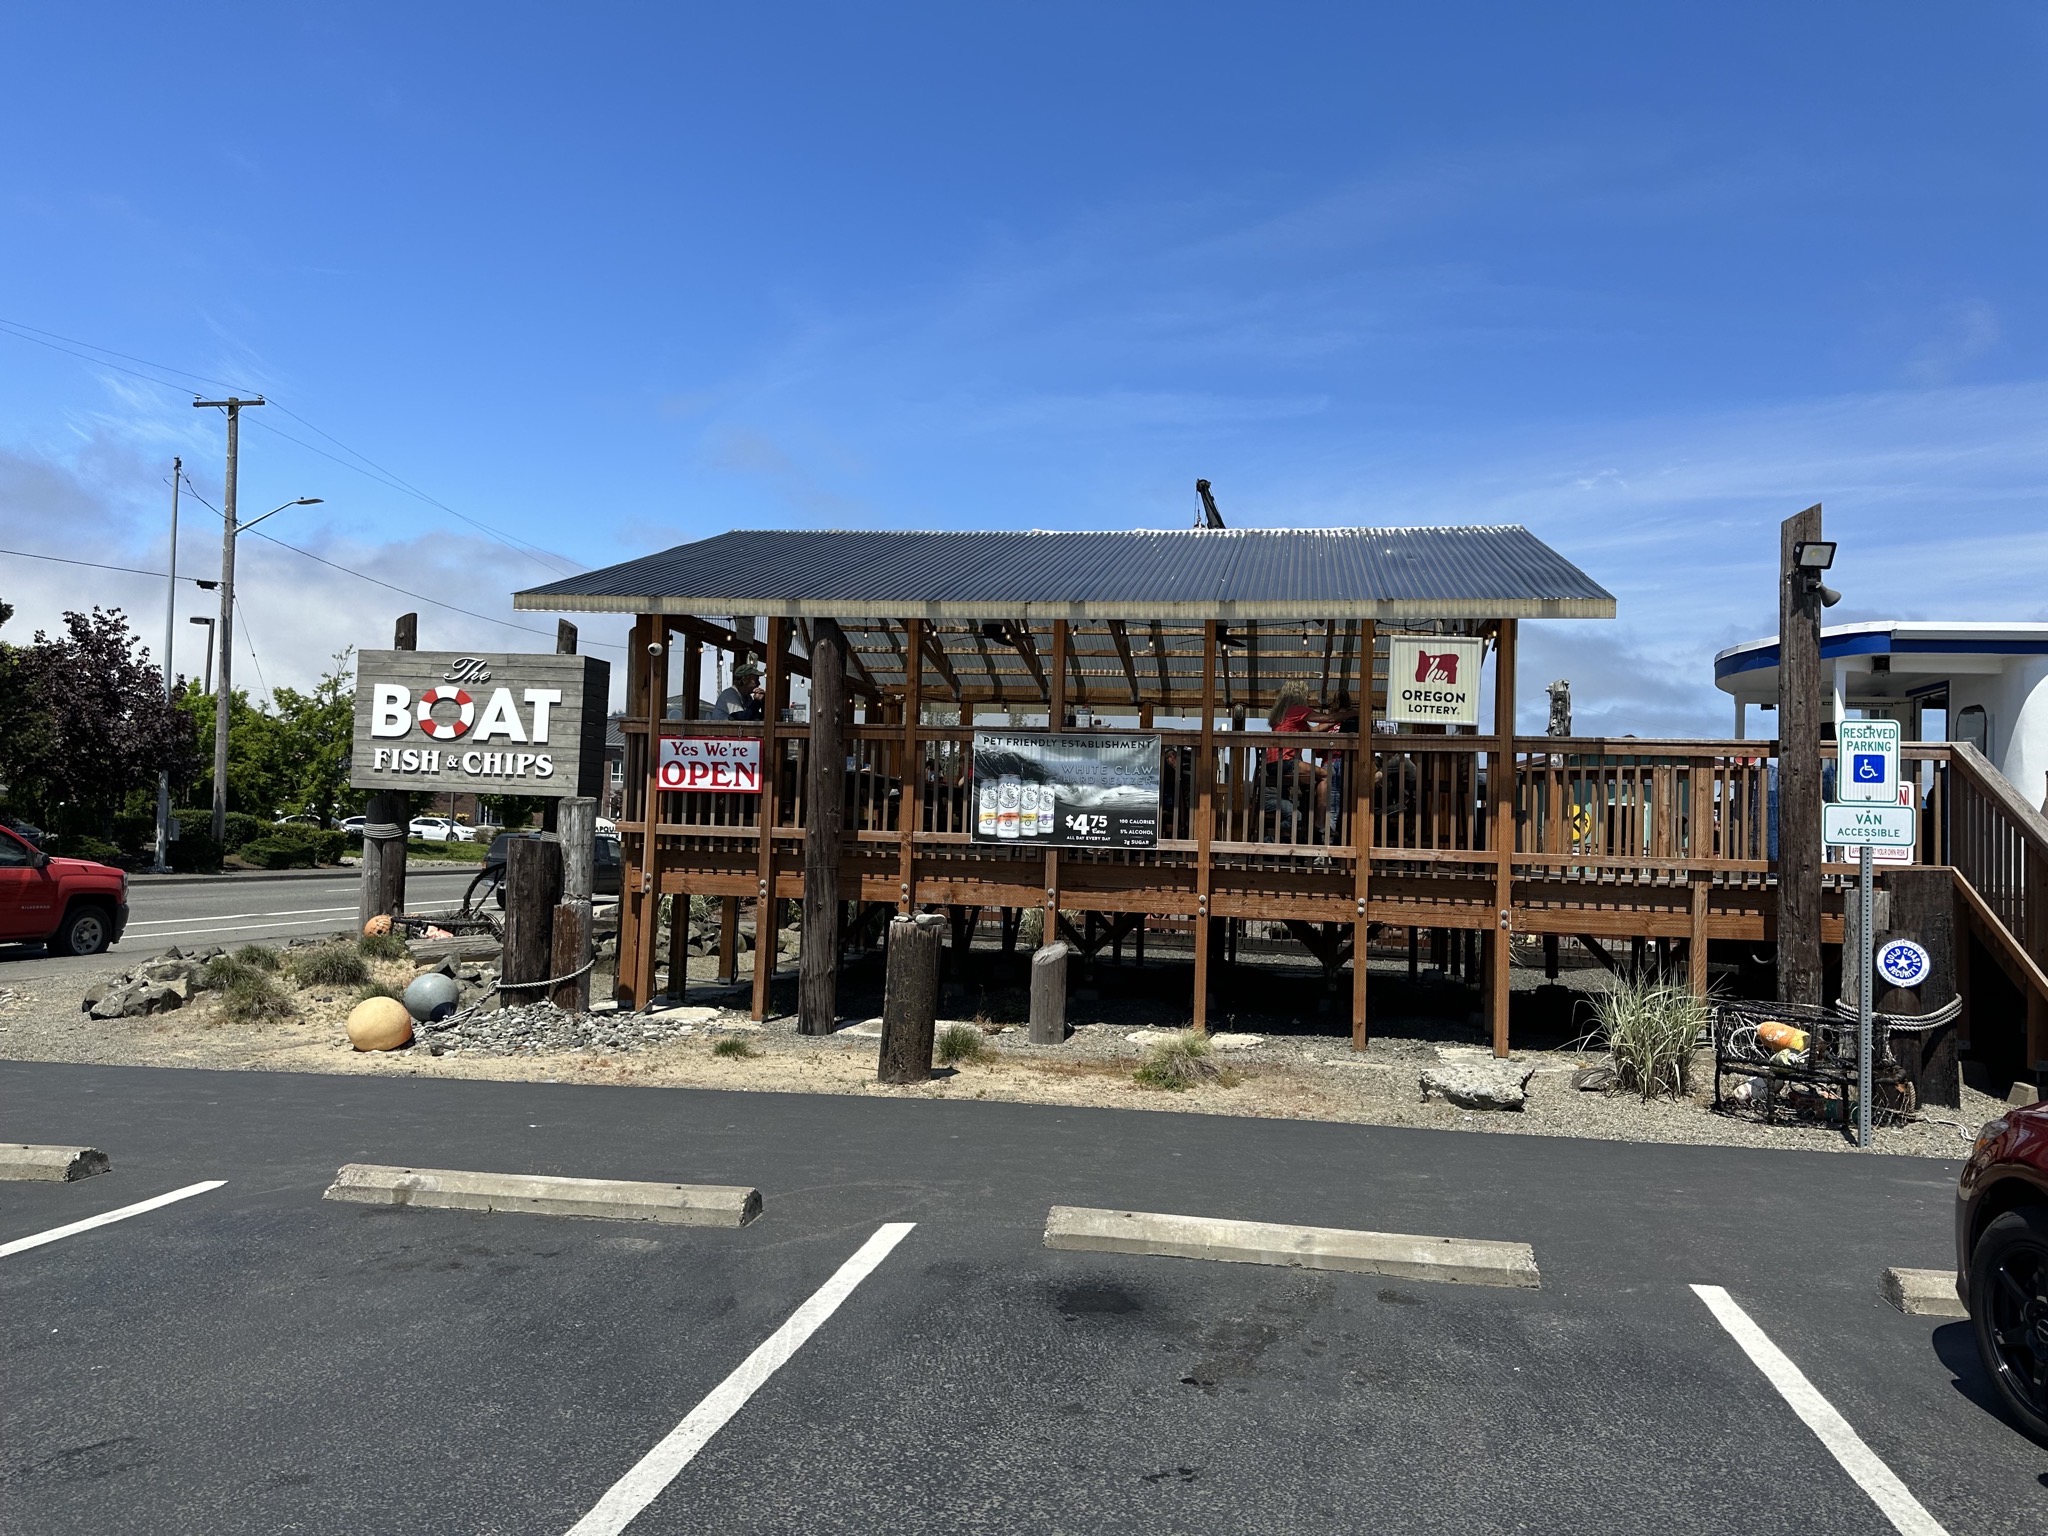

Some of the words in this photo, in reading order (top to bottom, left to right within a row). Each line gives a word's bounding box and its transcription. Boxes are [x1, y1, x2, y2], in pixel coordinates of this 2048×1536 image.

[443, 656, 492, 682] The
[1402, 689, 1466, 704] OREGON
[371, 683, 562, 743] BOAT
[1843, 727, 1896, 739] RESERVED
[670, 742, 699, 757] Yes
[704, 742, 748, 757] We're
[983, 737, 1003, 745] PET
[1006, 738, 1058, 748] FRIENDLY
[1061, 740, 1151, 750] ESTABLISHMENT
[1846, 741, 1892, 752] PARKING
[373, 748, 442, 773] FISH
[446, 754, 459, 768] &
[462, 751, 554, 777] CHIPS
[662, 760, 757, 788] OPEN
[1061, 765, 1108, 775] WHITE
[1114, 765, 1153, 776] CLAW
[1062, 776, 1096, 785] HARD
[1101, 777, 1153, 786] SELTZER
[1855, 814, 1882, 825] VAN
[1837, 827, 1900, 838] ACCESSIBLE
[1886, 948, 1901, 964] GOLD
[1902, 948, 1921, 967] COAST
[1888, 965, 1919, 978] SECURITY
